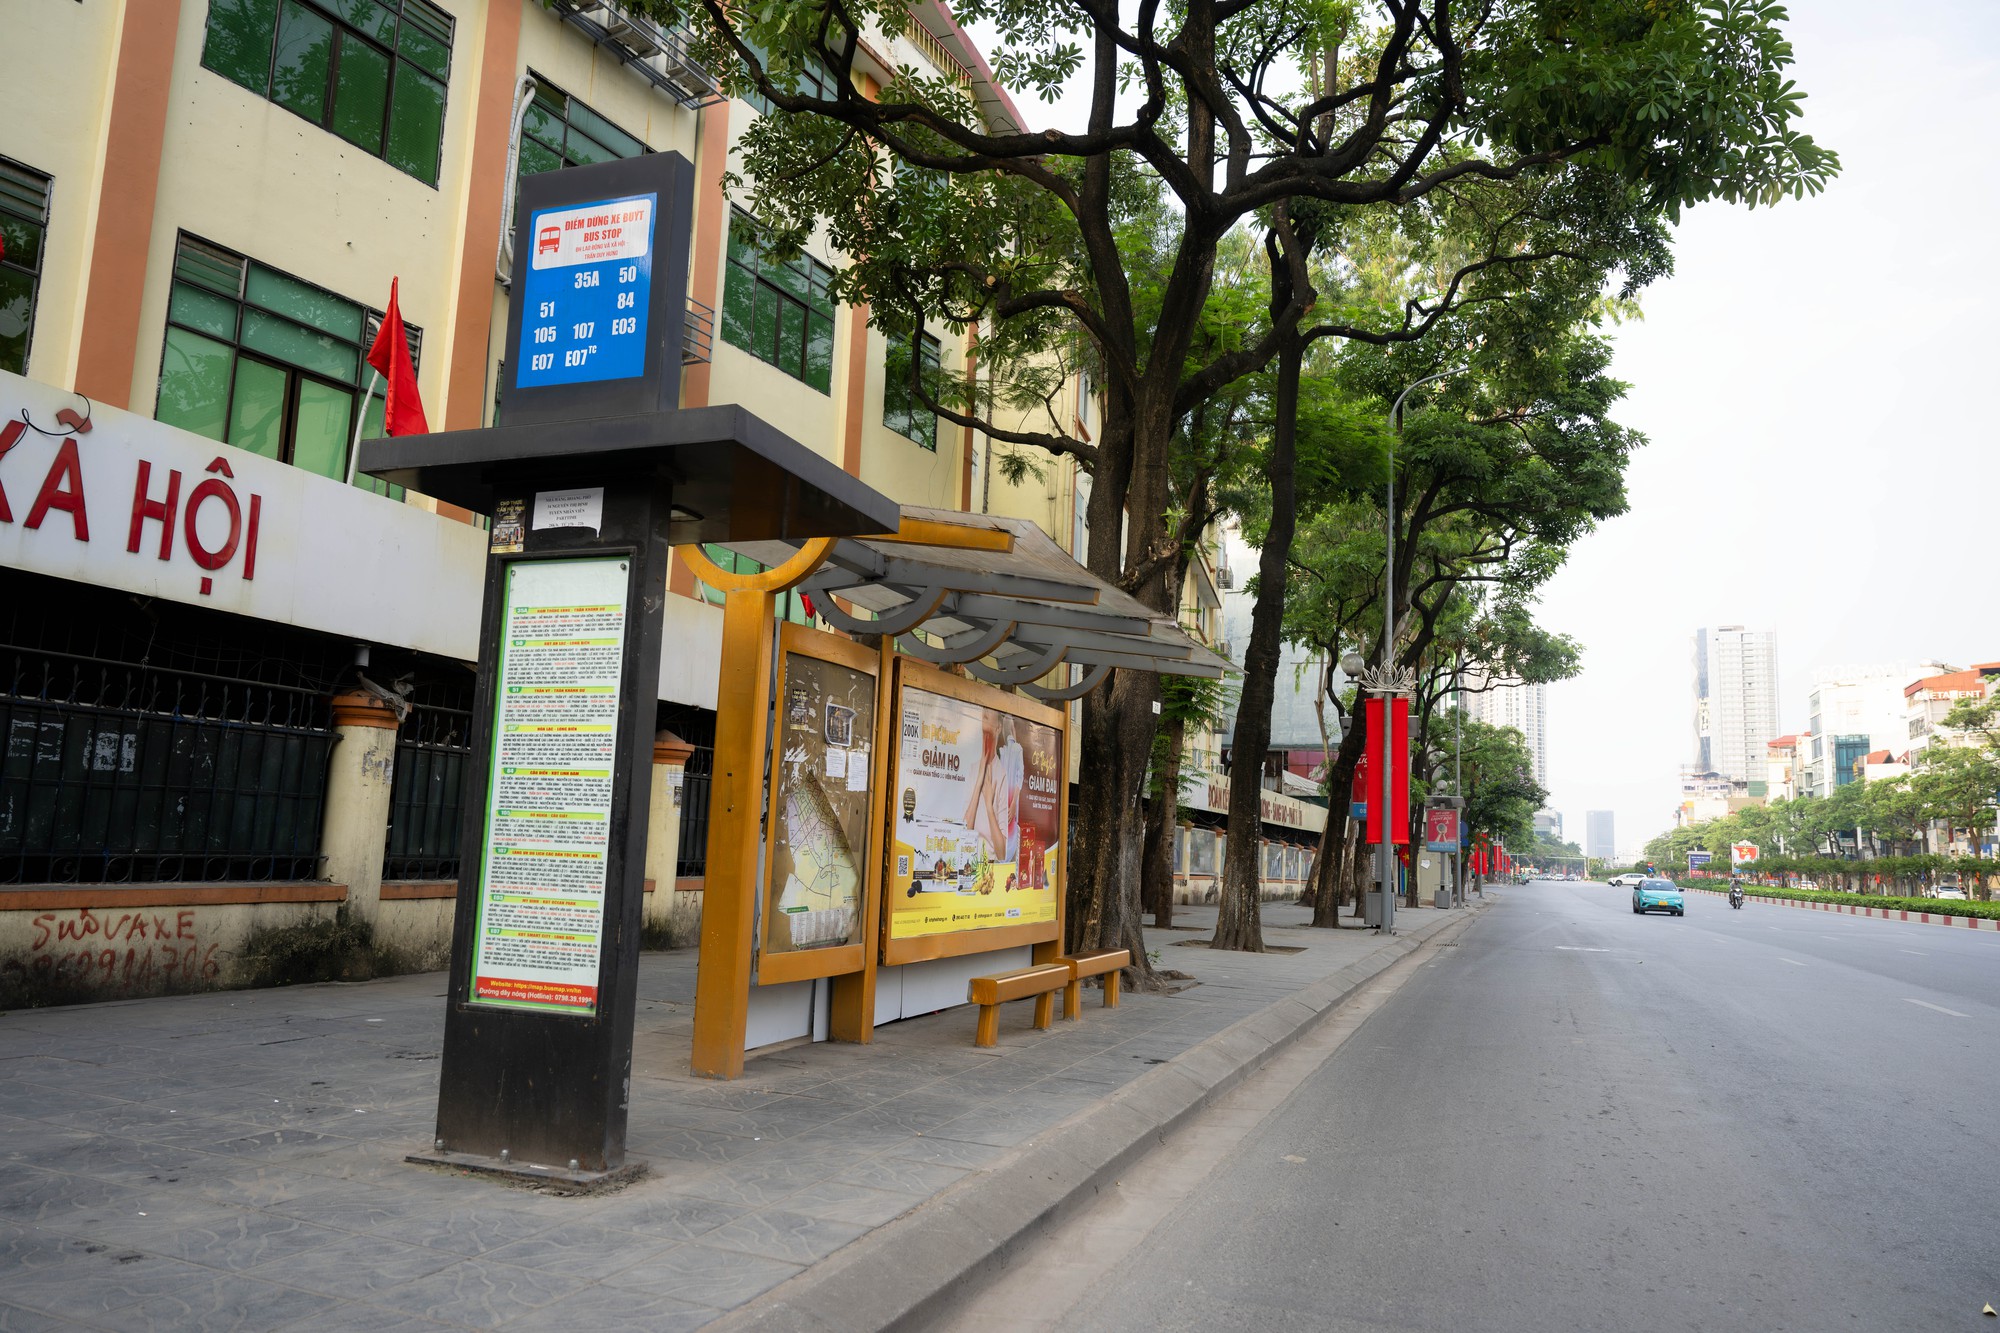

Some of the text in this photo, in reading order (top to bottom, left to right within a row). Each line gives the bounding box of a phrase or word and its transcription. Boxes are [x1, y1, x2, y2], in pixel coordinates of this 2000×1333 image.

[611, 213, 622, 224] XE
[584, 228, 622, 242] BUS STOP
[575, 266, 636, 289] 35A 50
[540, 292, 634, 318] 51 84
[534, 317, 636, 344] 105 107 E03
[532, 353, 554, 371] E07
[126, 457, 261, 596] HỘI
[904, 724, 919, 739] 200K
[922, 745, 946, 770] GIẢM
[947, 753, 960, 772] HO
[1029, 770, 1045, 792] GIẢM
[479, 987, 499, 996] Đường
[490, 980, 513, 988] Website:
